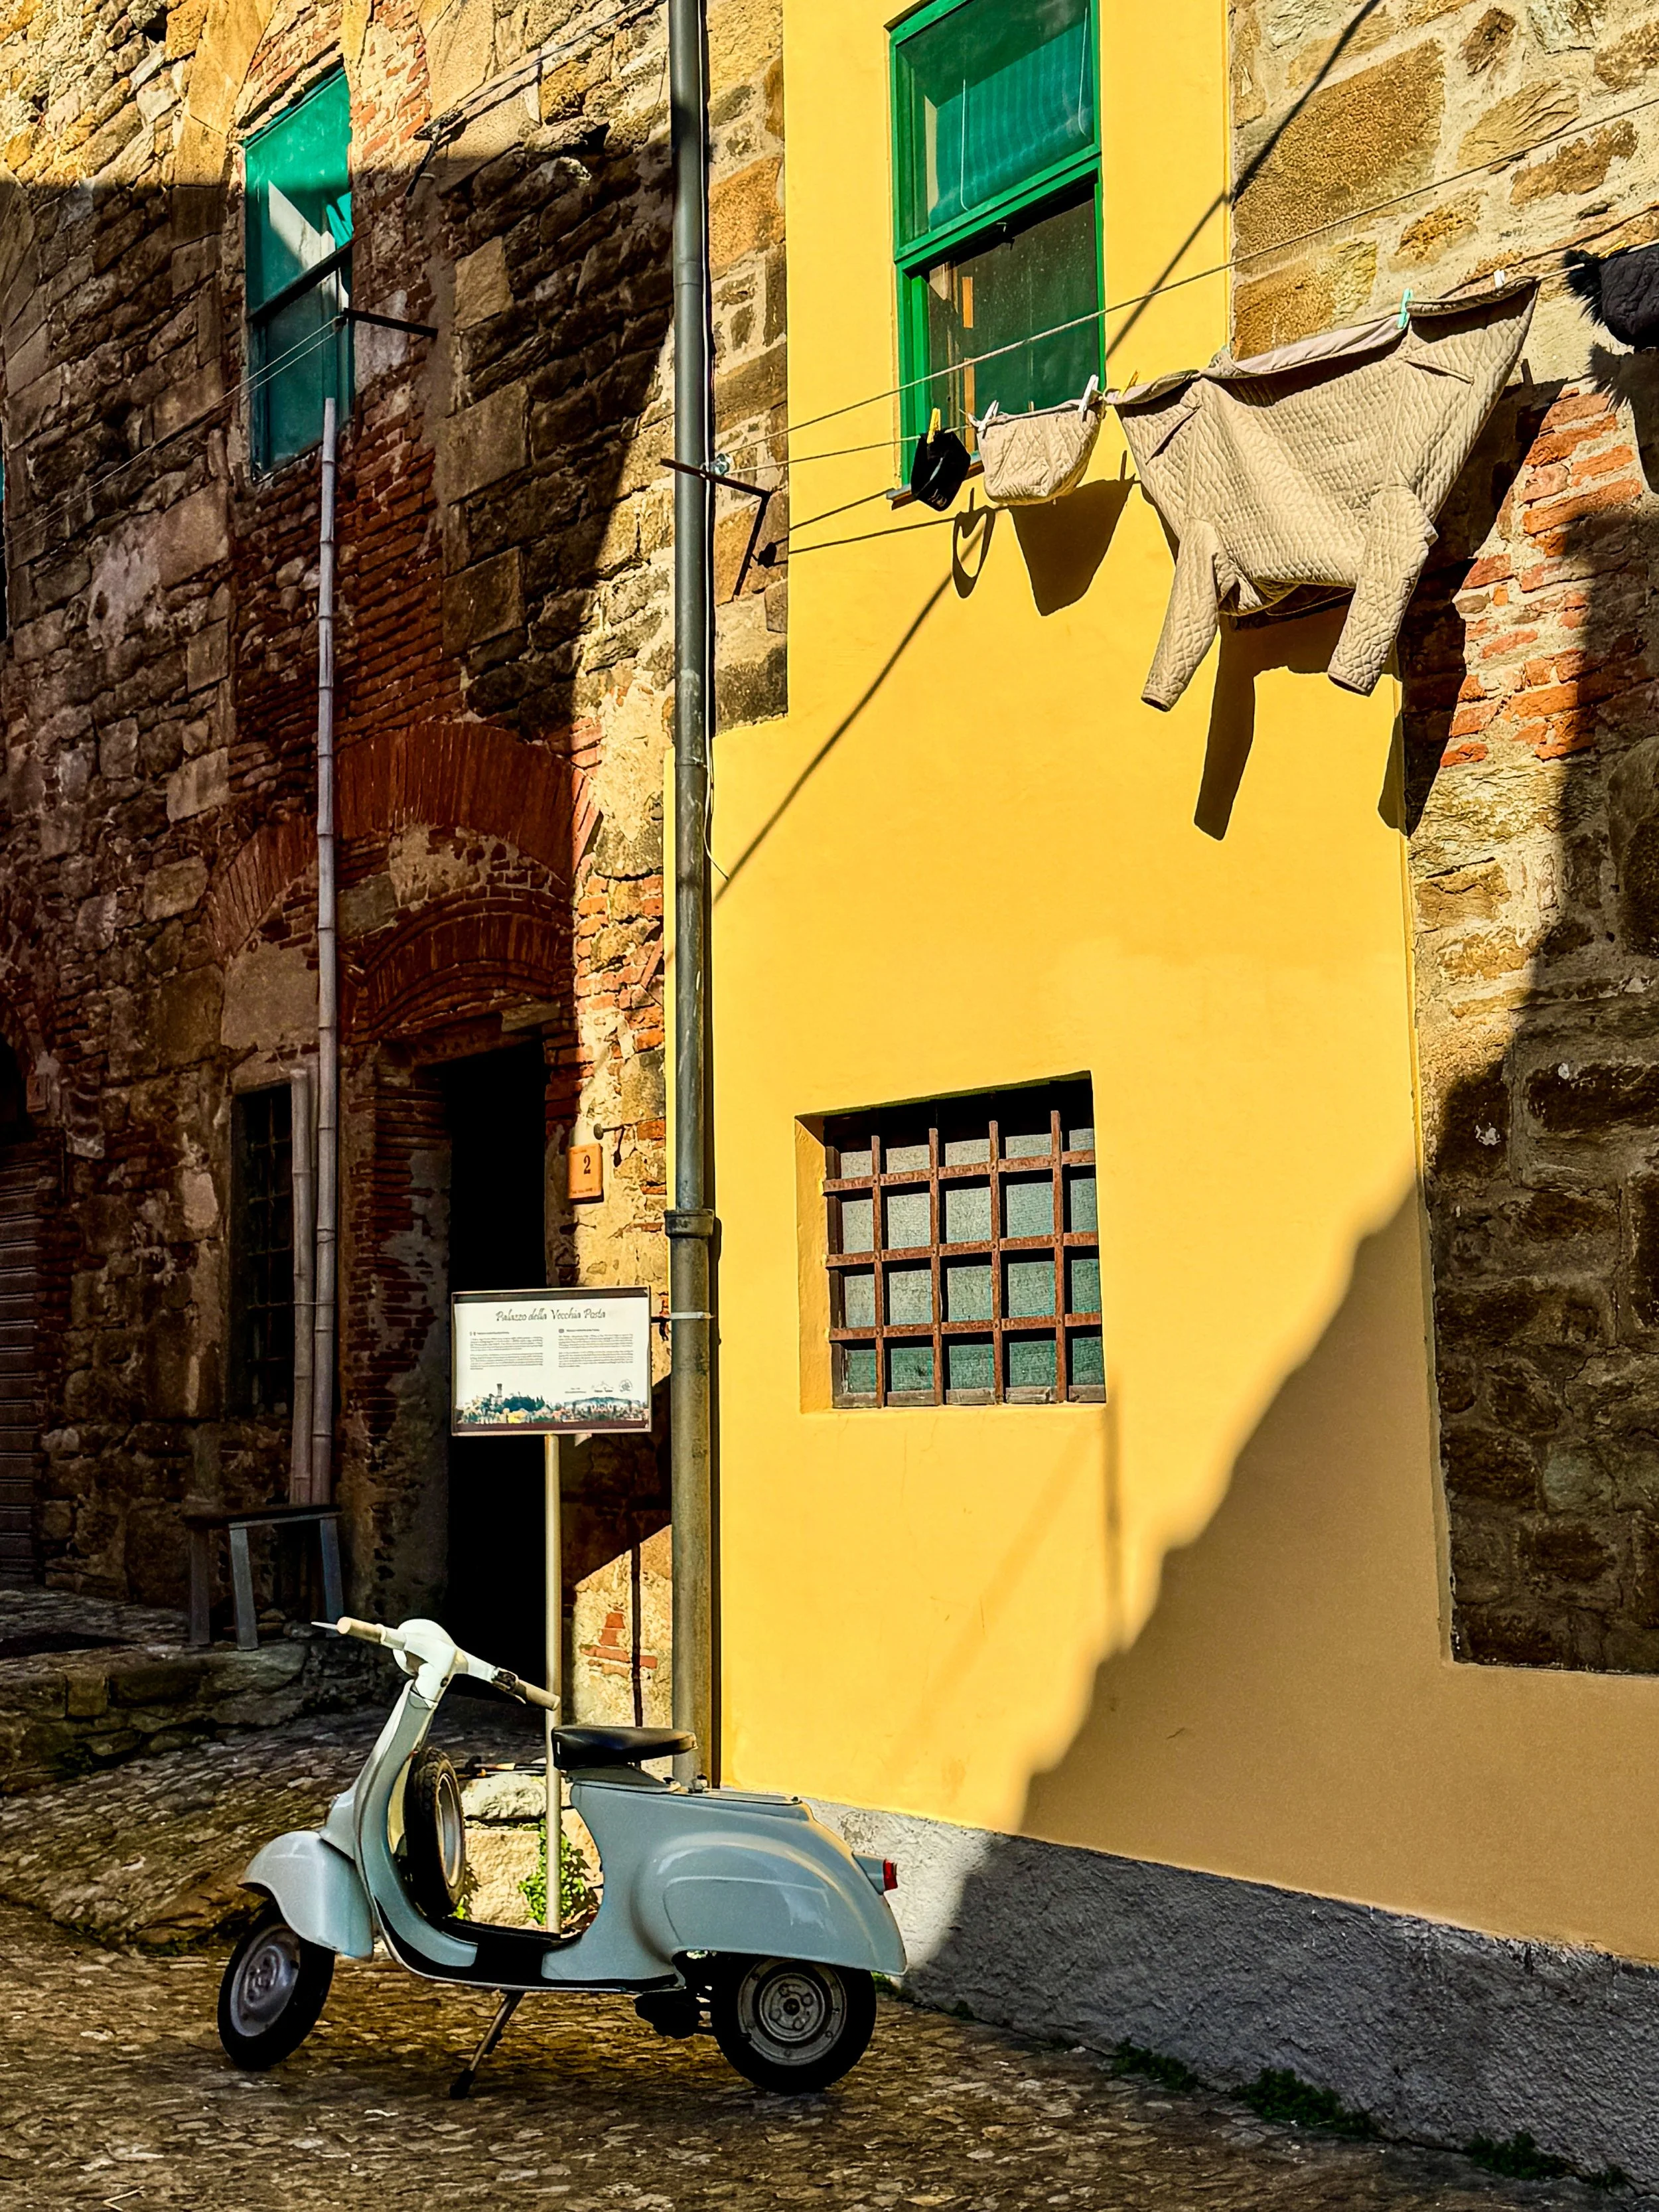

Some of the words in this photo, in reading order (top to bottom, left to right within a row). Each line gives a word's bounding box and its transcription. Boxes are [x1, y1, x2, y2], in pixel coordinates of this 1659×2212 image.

[583, 1155, 591, 1174] 2
[496, 1309, 527, 1321] Palazzo
[528, 1308, 547, 1320] della
[551, 1307, 581, 1319] Vecchia
[583, 1308, 606, 1319] Posta
